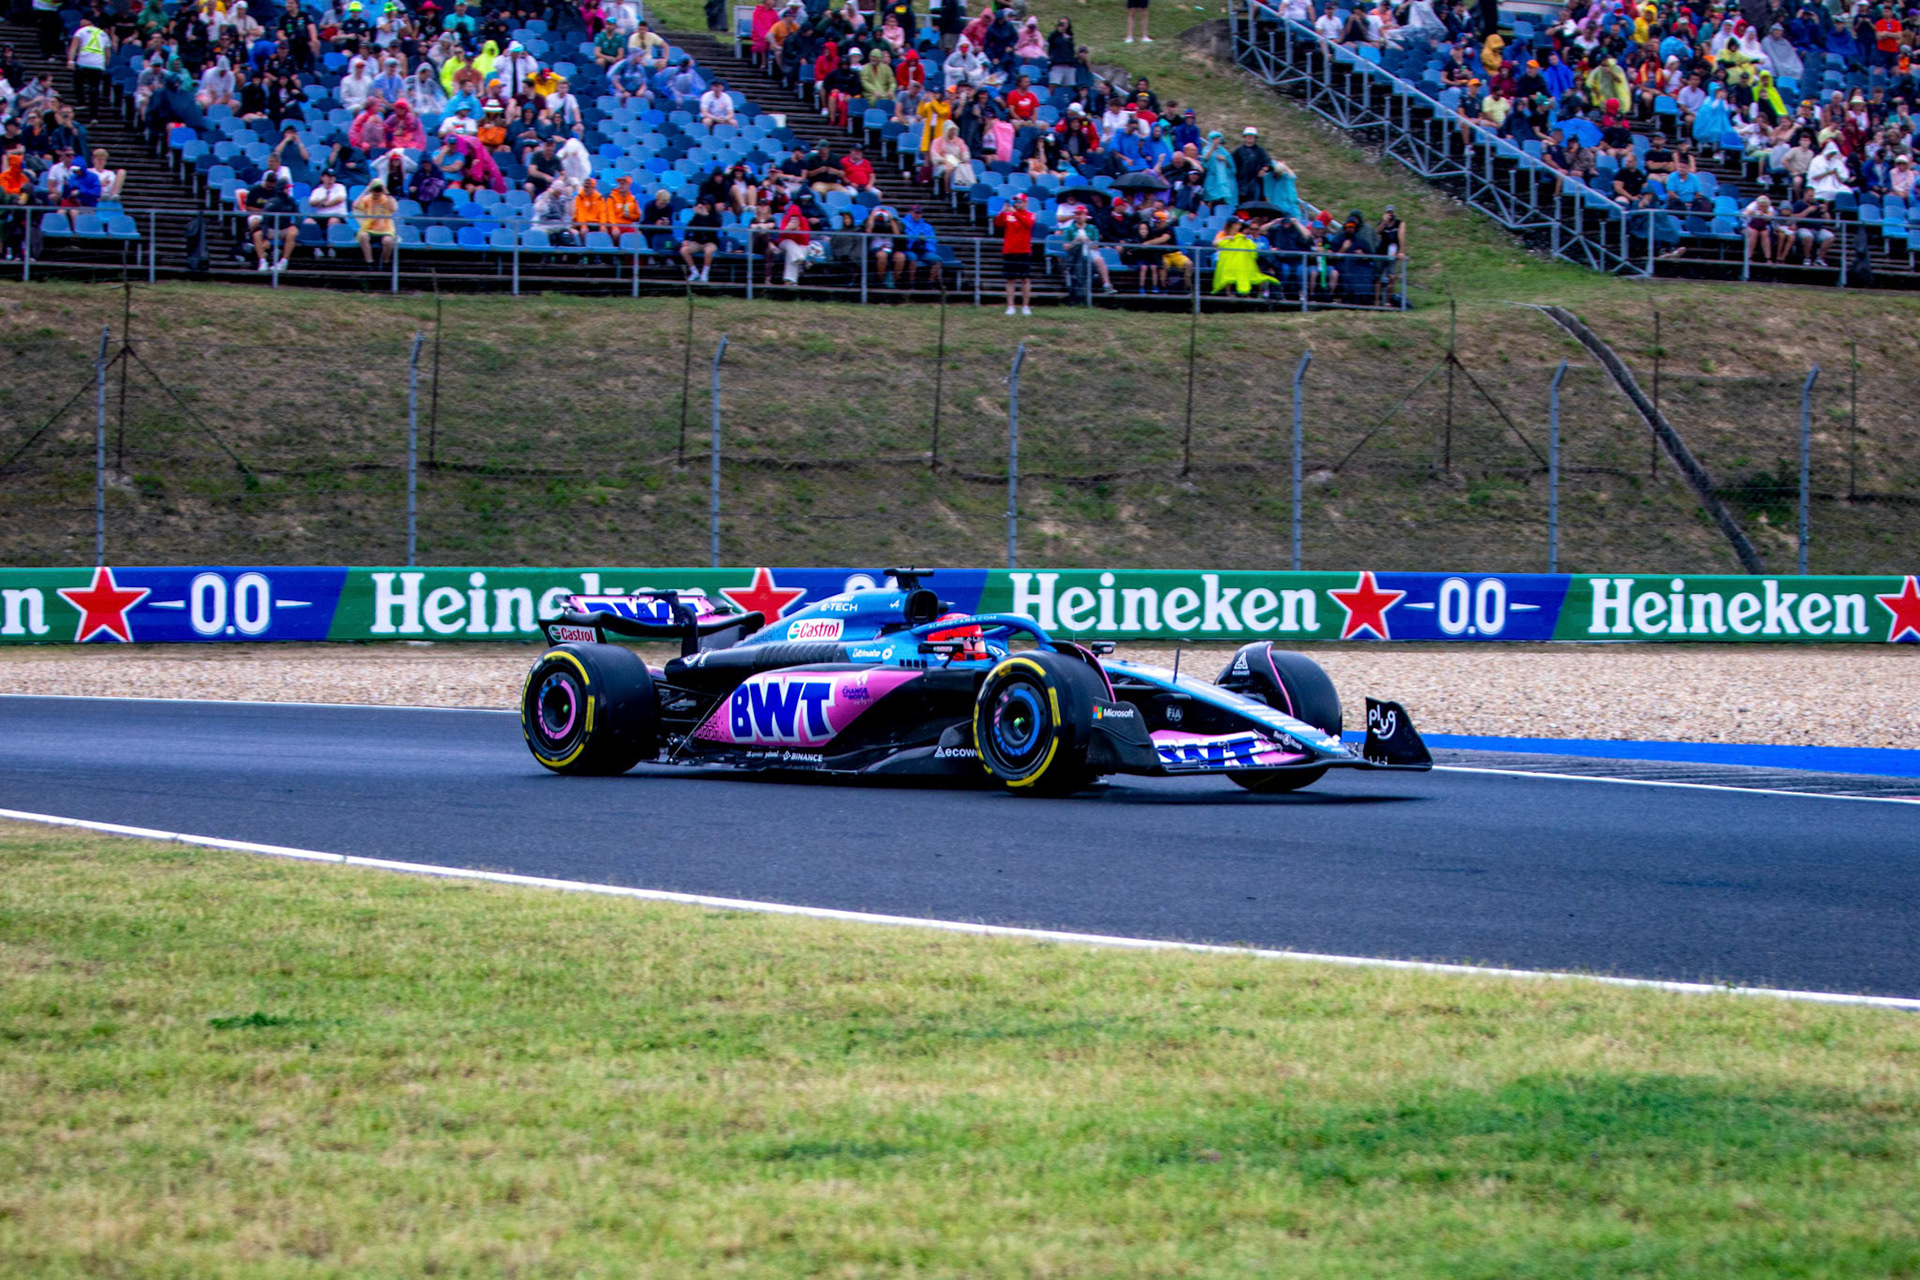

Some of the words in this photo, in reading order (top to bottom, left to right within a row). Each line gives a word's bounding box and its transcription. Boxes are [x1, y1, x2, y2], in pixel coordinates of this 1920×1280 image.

[190, 572, 270, 635] 0.0
[370, 571, 707, 634] Heine
[800, 621, 840, 638] Castrol
[1009, 572, 1320, 632] Heineken
[1438, 577, 1506, 635] 0.0
[1588, 578, 1870, 635] Heineken
[561, 627, 595, 643] Castrol
[731, 681, 832, 738] BWT
[1103, 708, 1134, 718] Microsoft
[1368, 704, 1396, 740] plug
[790, 752, 823, 762] BINANCE
